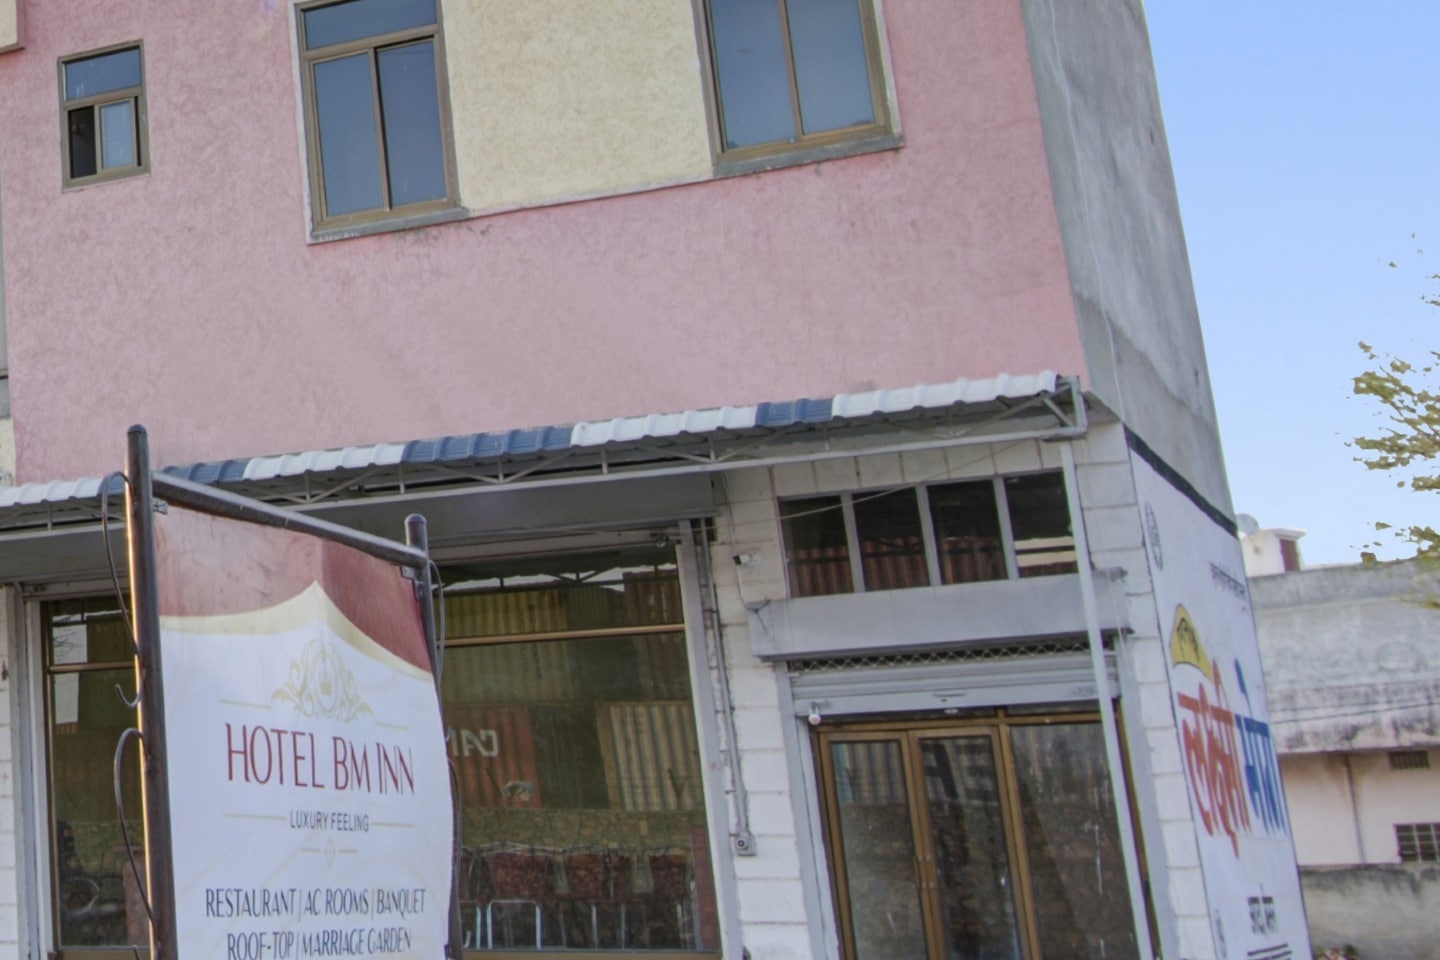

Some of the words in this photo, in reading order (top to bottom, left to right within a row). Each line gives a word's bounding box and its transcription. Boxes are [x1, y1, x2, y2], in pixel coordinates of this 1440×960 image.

[224, 722, 325, 789] HOTEL
[332, 736, 372, 794] BM
[377, 742, 416, 795] INN
[289, 811, 329, 831] LUXURY
[330, 812, 370, 833] FEELING
[205, 887, 297, 918] RESTAURANT
[304, 888, 321, 916] AC
[325, 888, 369, 916] ROOMS
[376, 888, 426, 920] BANQUET
[227, 930, 294, 960] ROOF-TOP
[301, 928, 366, 957] MARRIAGE
[367, 926, 412, 955] GARDEN
